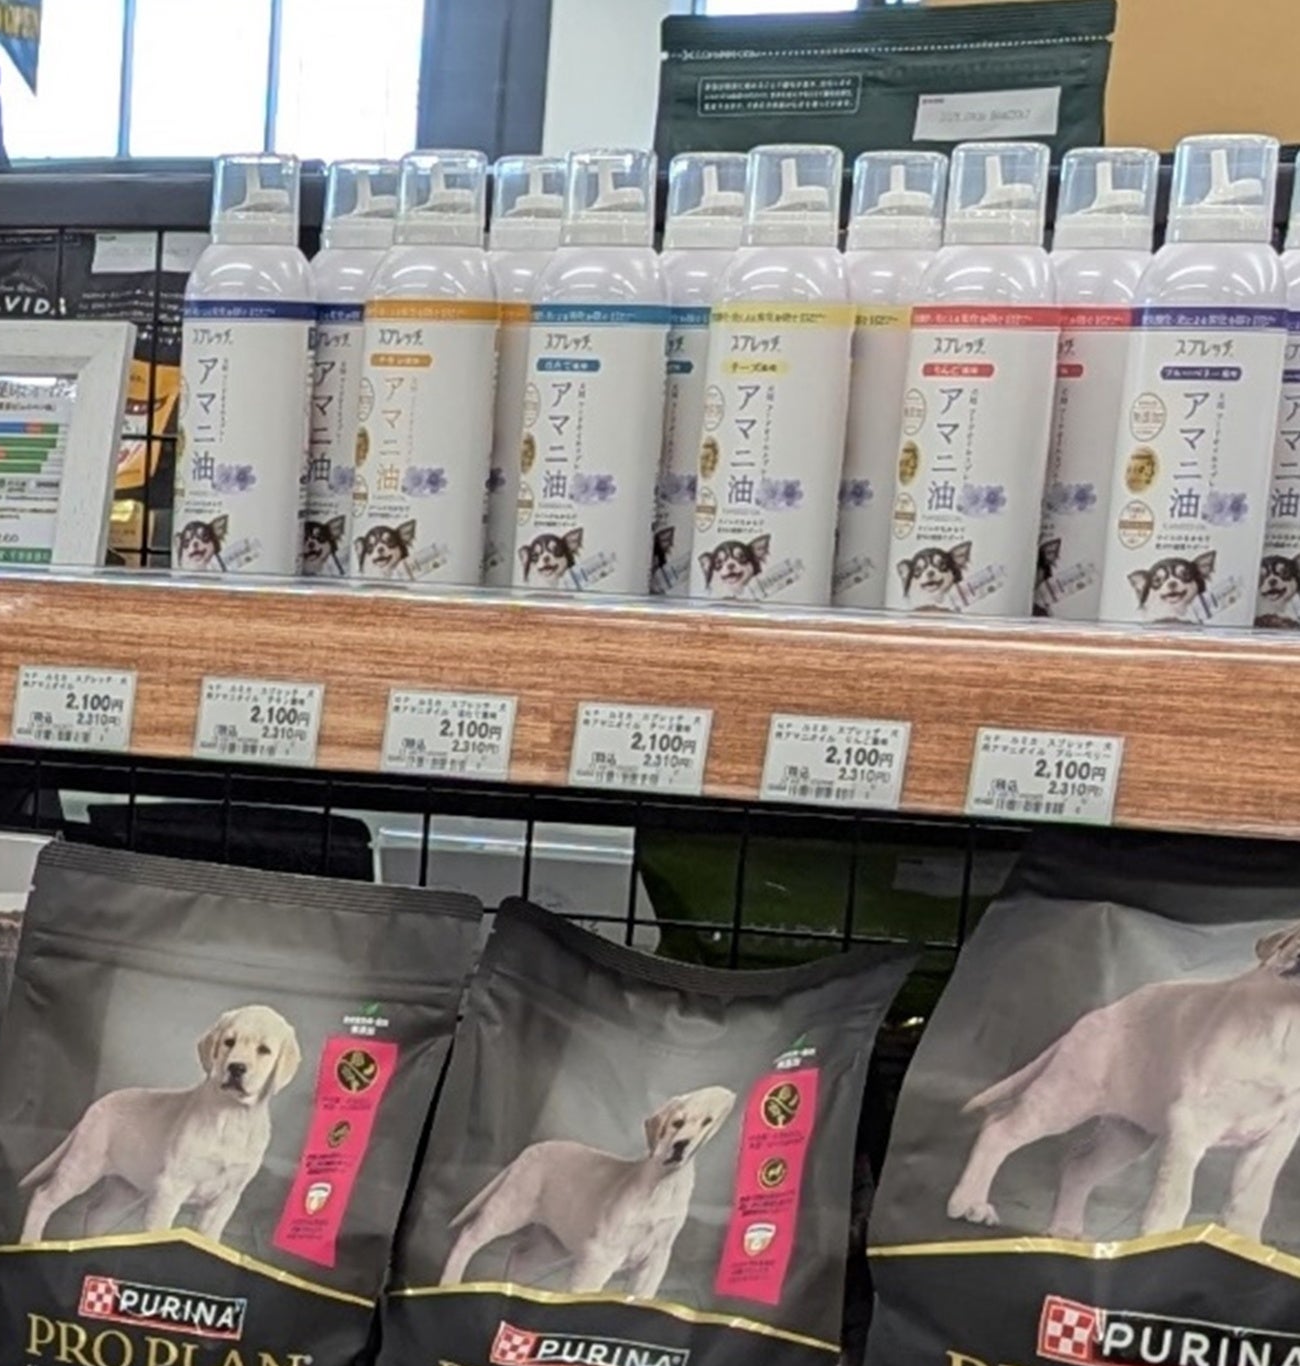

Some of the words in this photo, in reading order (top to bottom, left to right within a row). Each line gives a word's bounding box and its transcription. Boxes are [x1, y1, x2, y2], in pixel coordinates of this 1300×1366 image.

[190, 357, 218, 483] アマニ油
[376, 376, 406, 493] アマニ油
[542, 381, 571, 500] アマニ油
[727, 384, 761, 505] アマニ油
[926, 388, 965, 512] アマニ油
[1168, 391, 1211, 518] アマニ油
[65, 692, 124, 714] 2,100円
[249, 705, 311, 726] 2,100円
[438, 719, 503, 741] 2,100円
[630, 732, 696, 755] 2,100円
[824, 745, 895, 768] 2,100円
[1033, 759, 1106, 782] 2,100円
[119, 1288, 237, 1330] PURINA
